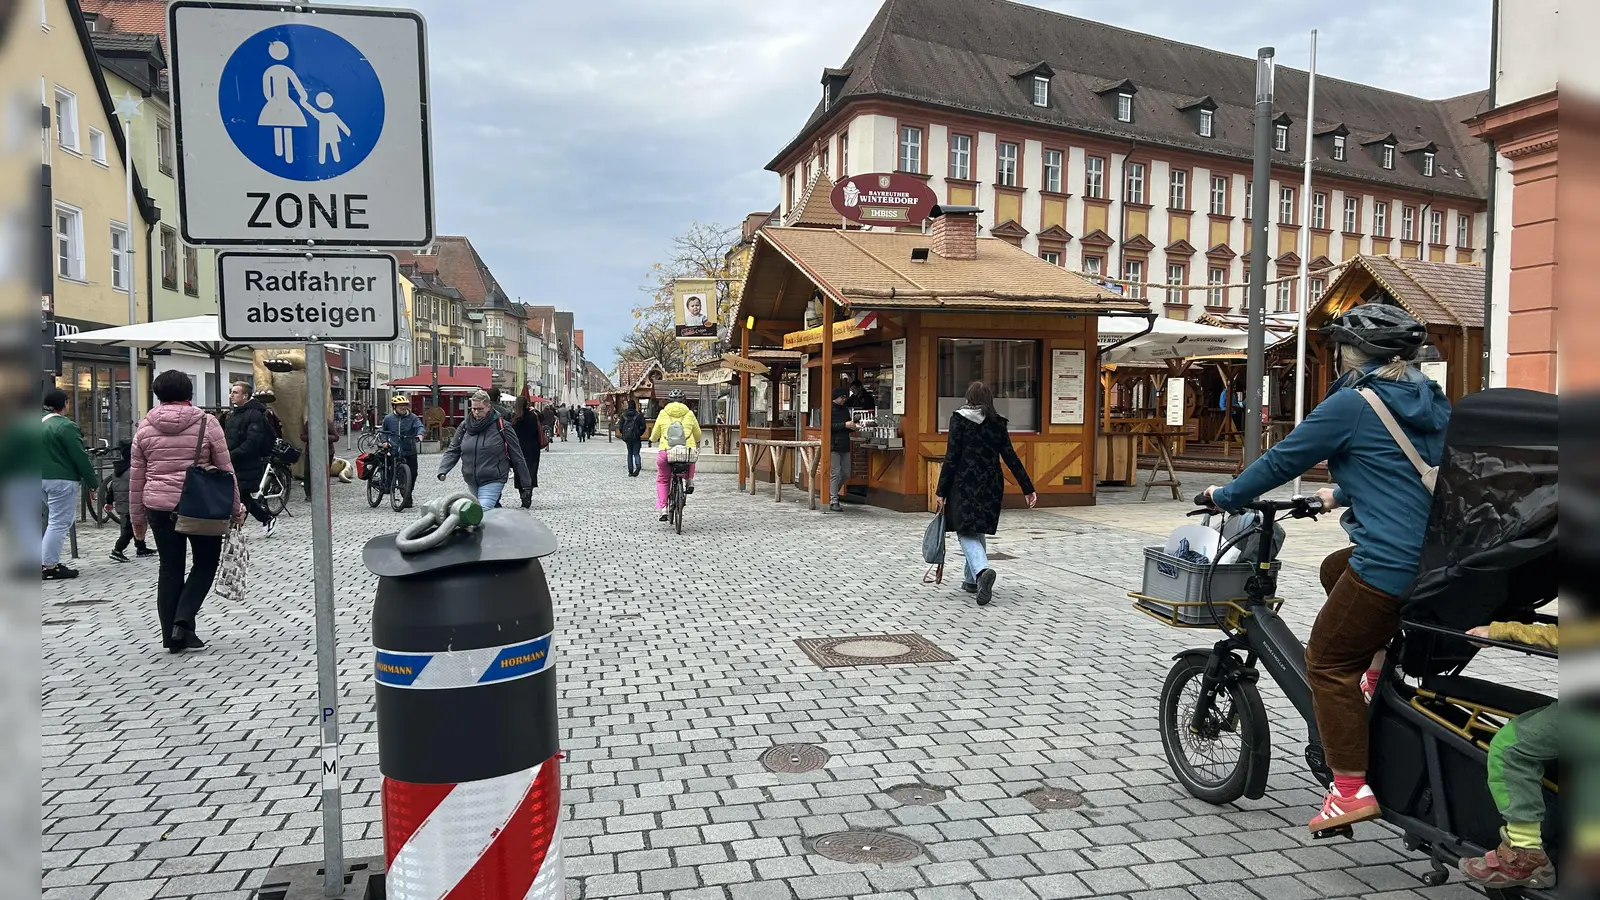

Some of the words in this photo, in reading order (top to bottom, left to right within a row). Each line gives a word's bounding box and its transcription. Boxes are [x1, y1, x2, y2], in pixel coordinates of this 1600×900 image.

[859, 195, 919, 204] WINTERDORF
[246, 192, 370, 229] ZONE
[870, 209, 898, 218] IMBISS
[244, 270, 377, 291] Radfahrer
[246, 302, 376, 328] absteigen
[733, 360, 757, 371] Kasse
[323, 707, 335, 723] P
[323, 759, 337, 776] M
